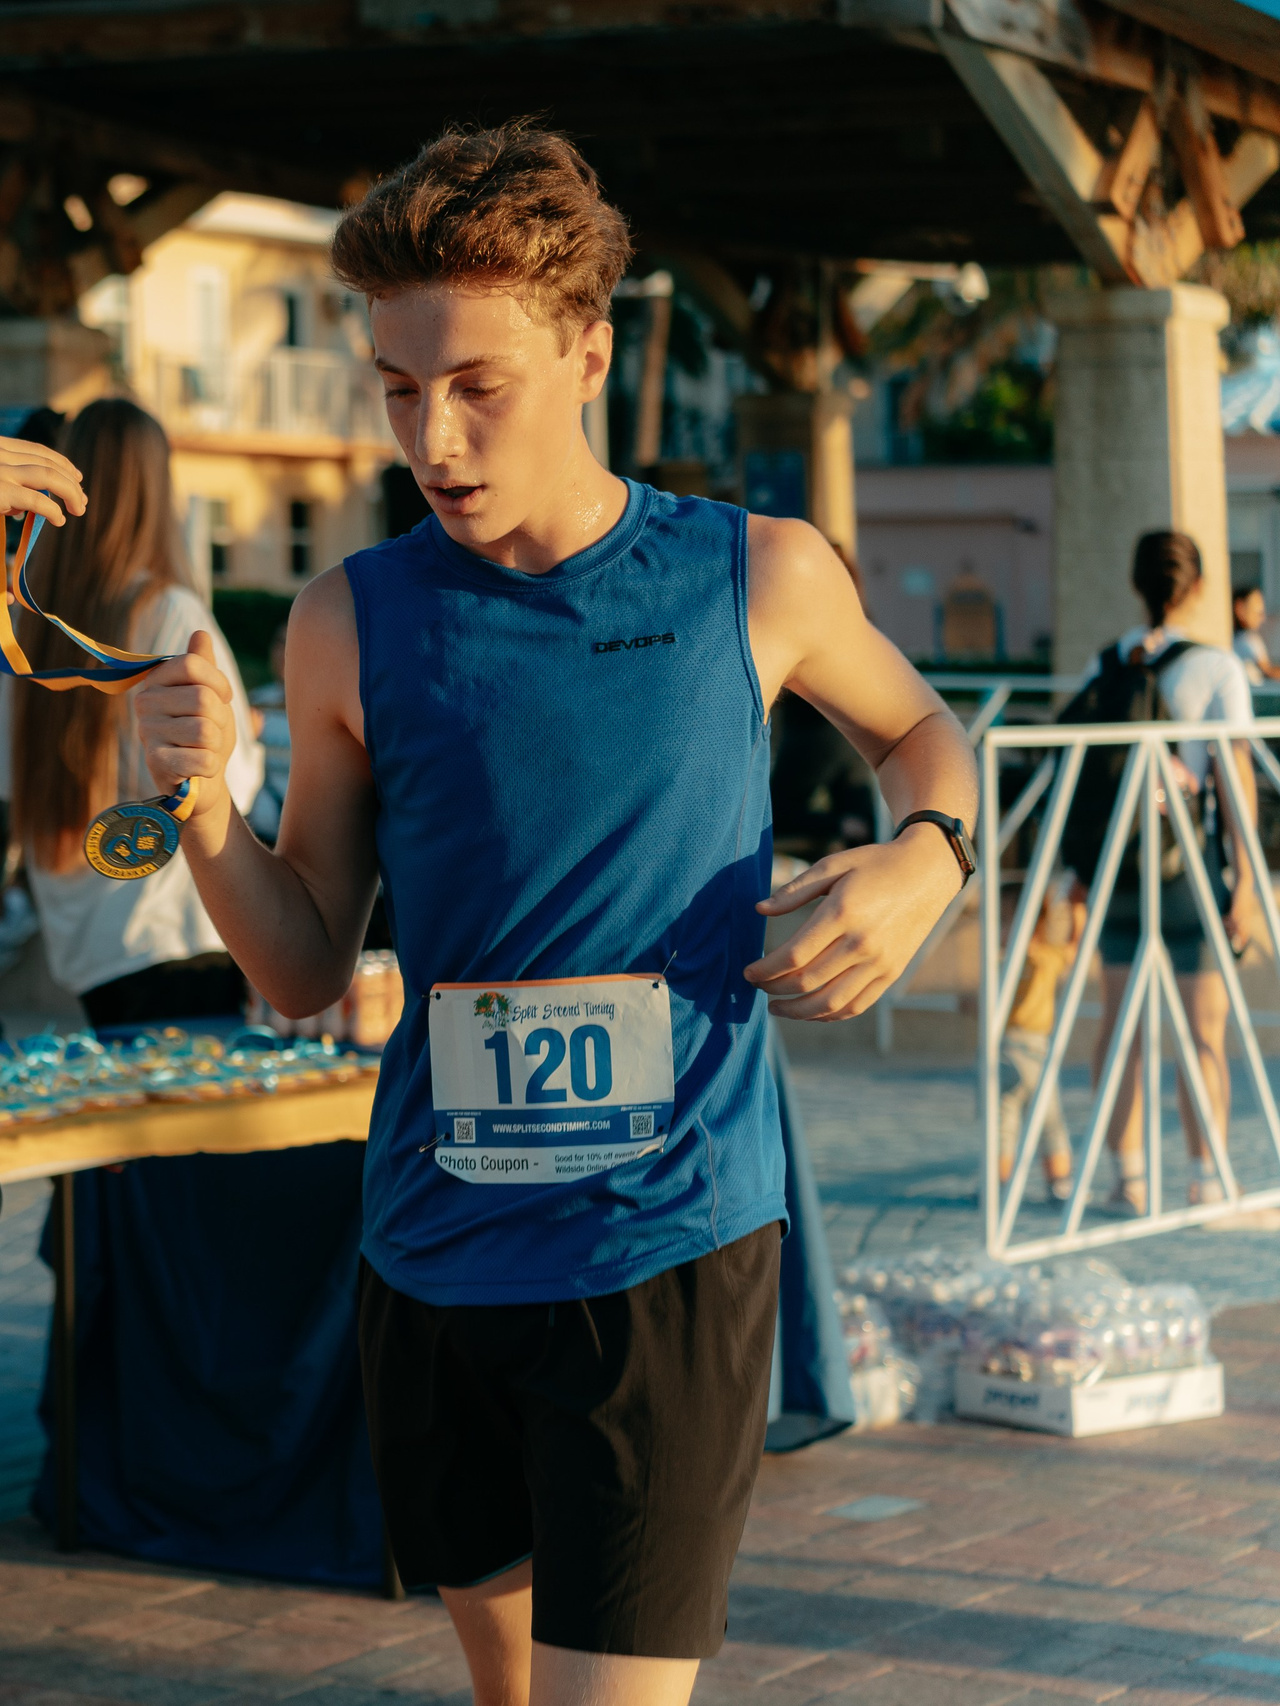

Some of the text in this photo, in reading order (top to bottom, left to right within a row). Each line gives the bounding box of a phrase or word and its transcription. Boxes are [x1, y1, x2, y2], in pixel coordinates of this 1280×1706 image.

[595, 632, 676, 653] DEVOPS
[512, 1001, 615, 1023] Split Second Timing
[484, 1024, 613, 1104] 120
[492, 1119, 611, 1134] WWW.SPLITSECONDTIMING.COM
[440, 1155, 477, 1171] Photo
[480, 1155, 529, 1174] Coupon
[554, 1153, 574, 1163] Good
[574, 1153, 585, 1162] for
[587, 1152, 602, 1162] 10%
[604, 1151, 614, 1160] off
[555, 1163, 585, 1174] Wildside
